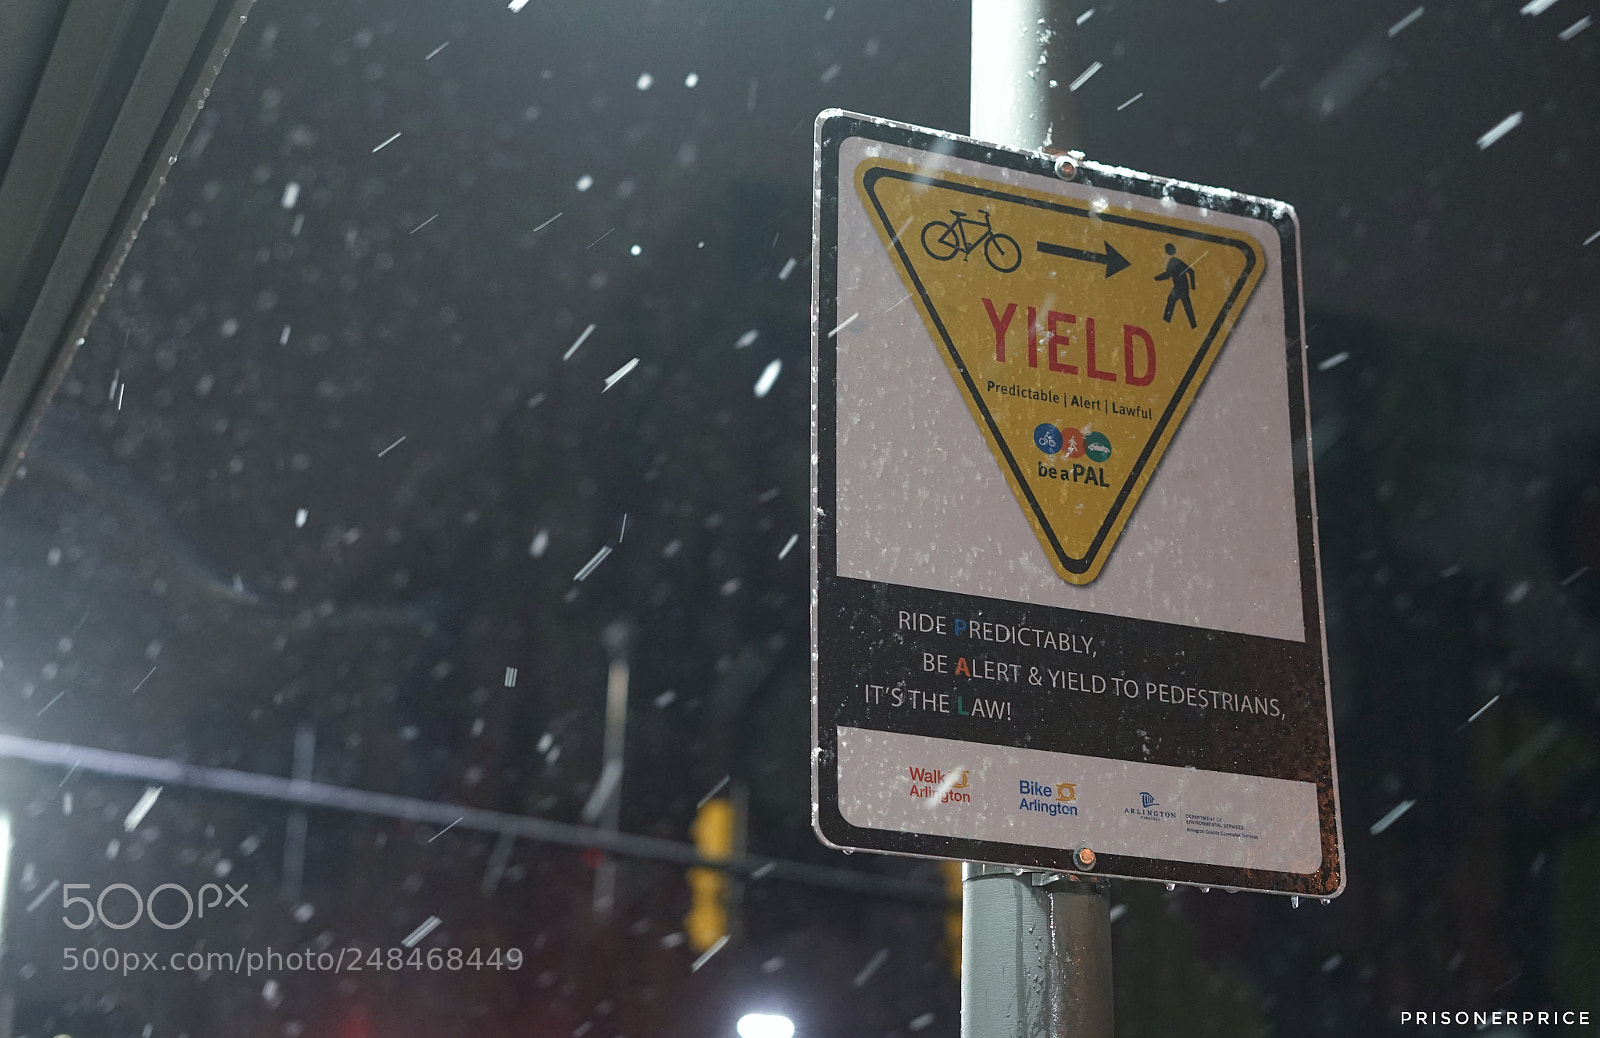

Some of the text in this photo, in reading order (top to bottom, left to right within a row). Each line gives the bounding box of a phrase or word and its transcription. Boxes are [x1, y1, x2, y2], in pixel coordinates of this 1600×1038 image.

[982, 297, 1157, 387] YIELD
[987, 380, 1060, 403] Predictable
[1070, 396, 1102, 411] Alert
[1112, 402, 1152, 419] Lawful
[1038, 461, 1110, 488] be a PAL
[899, 610, 1097, 658] RIDE PREDICTABLY,
[865, 684, 1012, 721] IT'S THE LAW!
[923, 652, 1286, 721] BE ALERT & YIELD TO PEDESTRIANS,
[909, 766, 945, 784] Walk
[1019, 780, 1052, 797] Bike
[1019, 797, 1078, 817] Arlington
[1124, 807, 1176, 819] ARLINGTON
